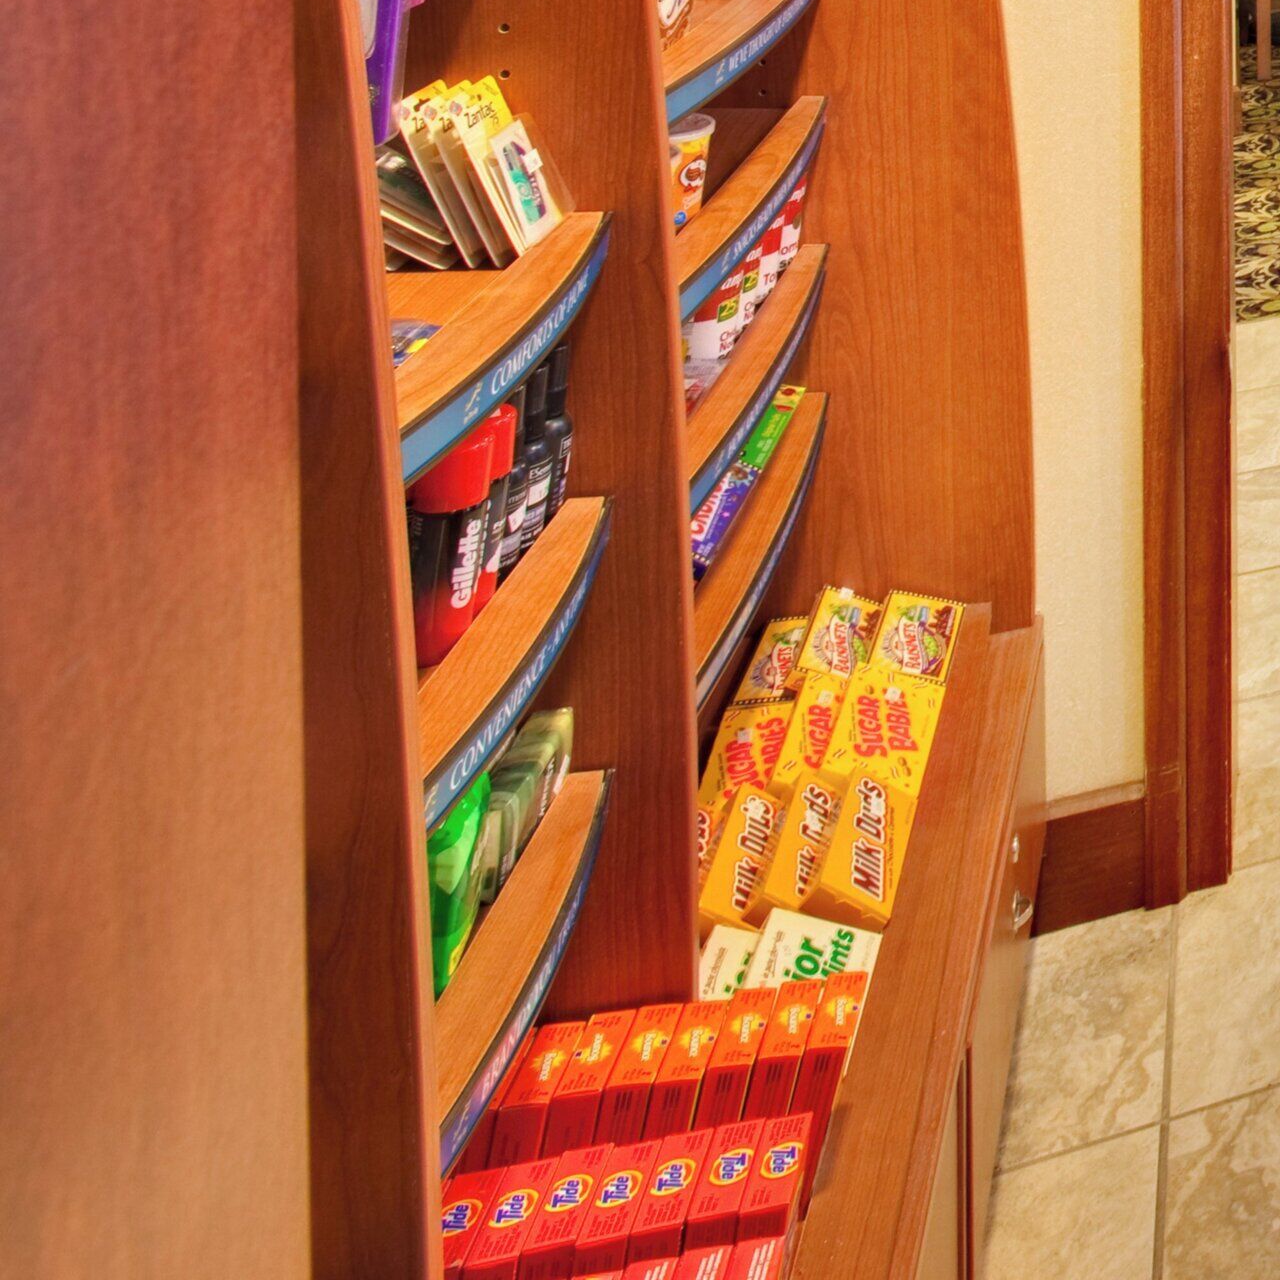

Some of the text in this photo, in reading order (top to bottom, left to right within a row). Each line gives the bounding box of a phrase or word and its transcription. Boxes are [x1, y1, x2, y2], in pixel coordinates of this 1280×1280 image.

[464, 100, 496, 129] Zantac
[723, 299, 739, 315] 25
[491, 313, 554, 395] COMFORTS
[450, 517, 482, 609] Gillette
[450, 645, 550, 791] CONVENIENCE
[853, 693, 888, 759] SUGAR
[803, 704, 833, 770] SUGAR
[850, 837, 884, 902] Milk
[721, 1152, 747, 1182] Tide
[772, 1145, 797, 1175] Tide
[602, 1174, 630, 1204] Tide
[656, 1162, 684, 1192] Tide
[551, 1178, 580, 1209] Tide
[496, 1194, 525, 1224] Tide
